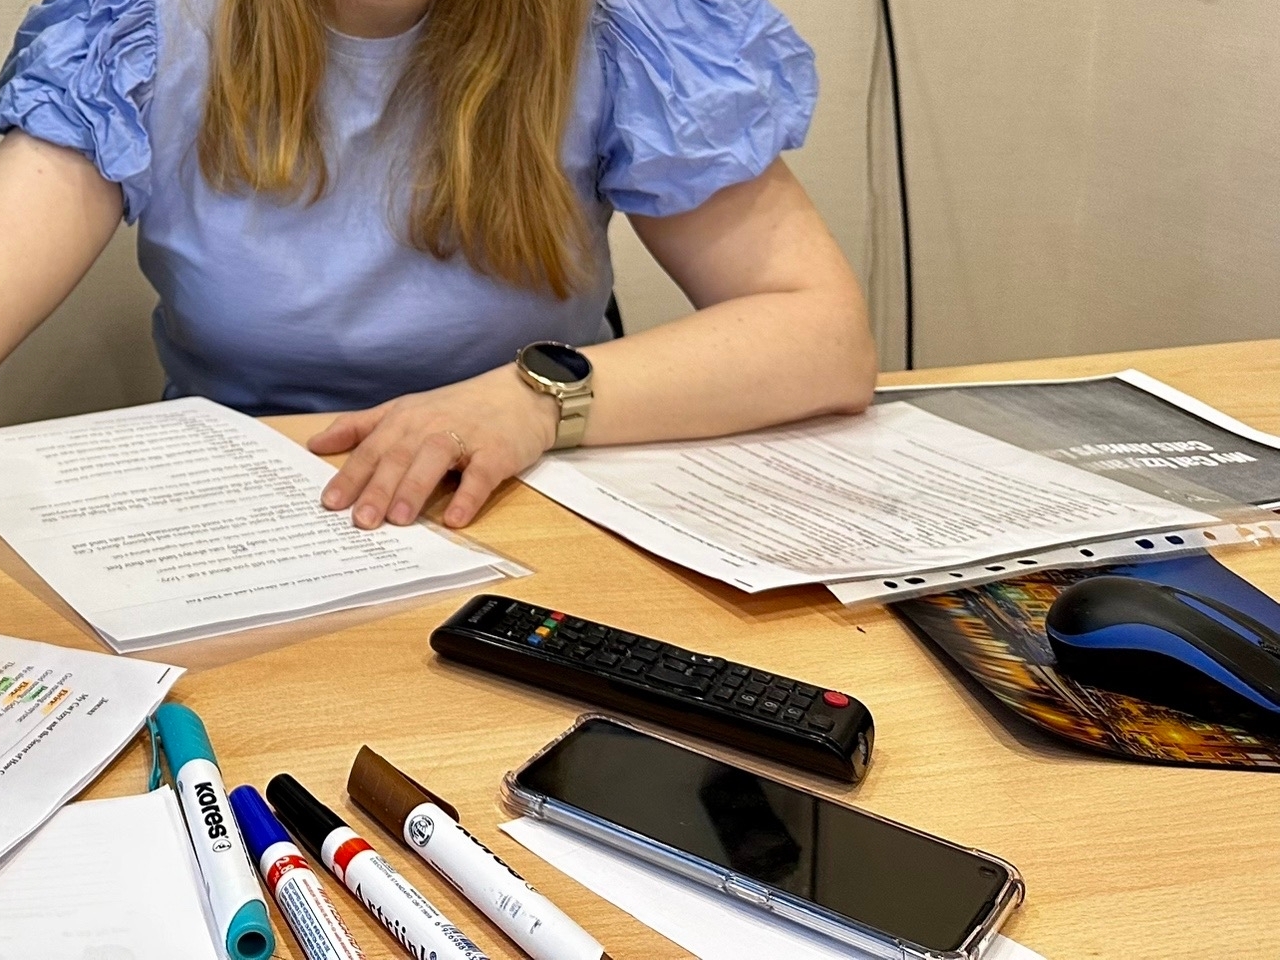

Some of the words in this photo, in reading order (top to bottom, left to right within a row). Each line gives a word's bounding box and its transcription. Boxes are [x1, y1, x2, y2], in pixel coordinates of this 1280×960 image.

[1069, 442, 1160, 457] Always
[1152, 440, 1214, 456] Cats
[1166, 455, 1218, 469] Cat
[1209, 451, 1257, 464] My
[36, 669, 54, 681] Good
[55, 672, 73, 685] Good
[74, 693, 89, 702] My
[0, 699, 22, 713] Today
[66, 702, 80, 711] Cat
[54, 710, 72, 721] Izzy
[45, 720, 59, 731] and
[37, 730, 50, 738] the
[20, 738, 41, 753] Secret
[1, 758, 19, 770] How
